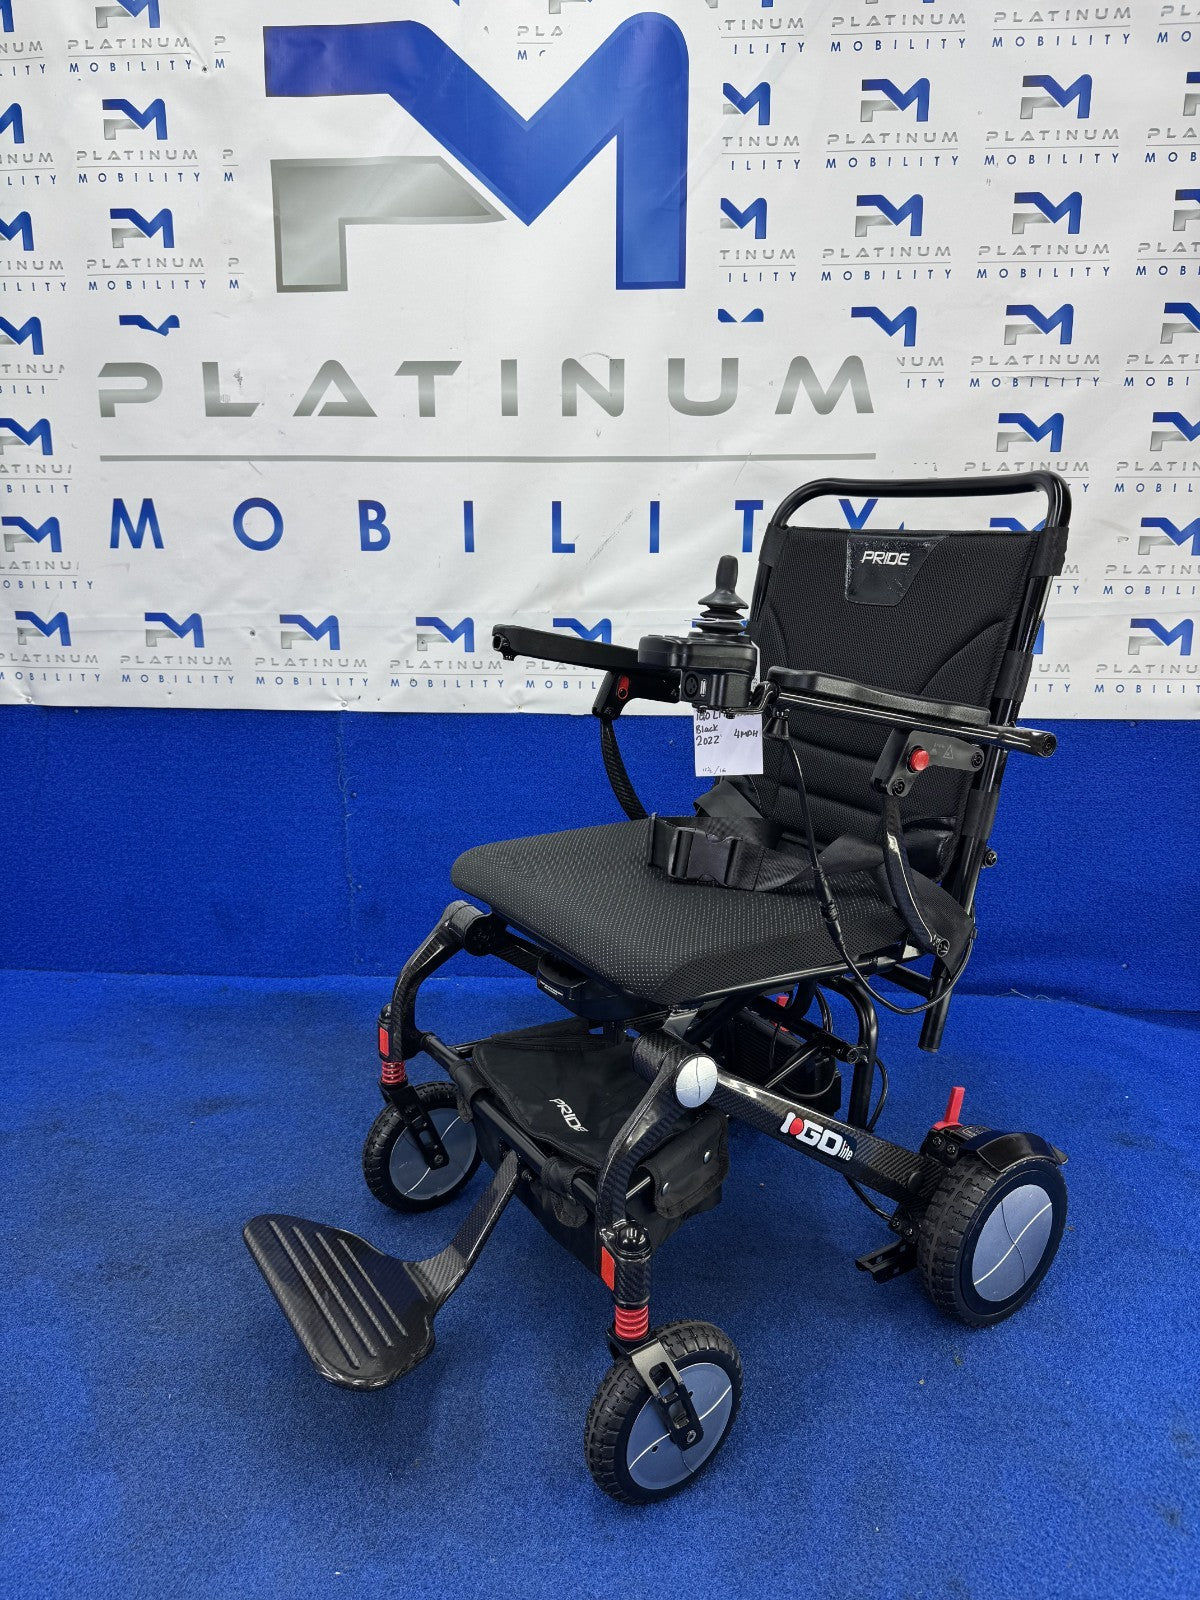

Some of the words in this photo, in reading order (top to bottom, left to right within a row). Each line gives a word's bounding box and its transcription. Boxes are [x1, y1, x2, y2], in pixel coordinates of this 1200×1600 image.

[993, 6, 1131, 22] PLATINUM
[831, 13, 966, 29] PLATINUM
[67, 36, 191, 50] PLATINUM
[830, 37, 966, 53] MOBILITY
[991, 32, 1130, 47] MOBILITY
[0, 63, 46, 77] ITY
[69, 59, 192, 73] MOBILITY
[827, 131, 959, 145] PLATINUM
[985, 128, 1120, 142] PLATINUM
[76, 149, 199, 161] PLATINUM
[984, 153, 1120, 166] MOBILITY
[825, 155, 960, 169] MOBILITY
[78, 172, 201, 184] MOBILITY
[822, 246, 952, 260] PLATINUM
[978, 243, 1110, 256] PLATINUM
[86, 257, 205, 269] PLATINUM
[821, 269, 952, 282] MOBILITY
[976, 266, 1110, 279] MOBILITY
[88, 279, 206, 291] MOBILITY
[970, 353, 1100, 366] PLATINUM
[98, 354, 876, 417] PLATINUM
[969, 376, 1100, 388] MOBILITY
[0, 384, 45, 395] ILI
[964, 460, 1090, 472] PLATINUM
[109, 496, 880, 552] MOBILITY
[860, 550, 911, 566] PRIDE
[0, 560, 80, 571] ATINU
[1105, 564, 1200, 575] PLATIN
[3, 580, 94, 590] OBILITY
[1102, 585, 1196, 595] MOBILI
[120, 655, 232, 666] PLATINUM
[255, 657, 368, 668] PLATINUM
[390, 659, 502, 670] PLATINUM
[526, 660, 576, 670] PLA
[121, 674, 234, 685] MOBILITY
[255, 676, 368, 687] MOBILITY
[390, 679, 504, 689] MOBILITY
[696, 735, 720, 746] 2022
